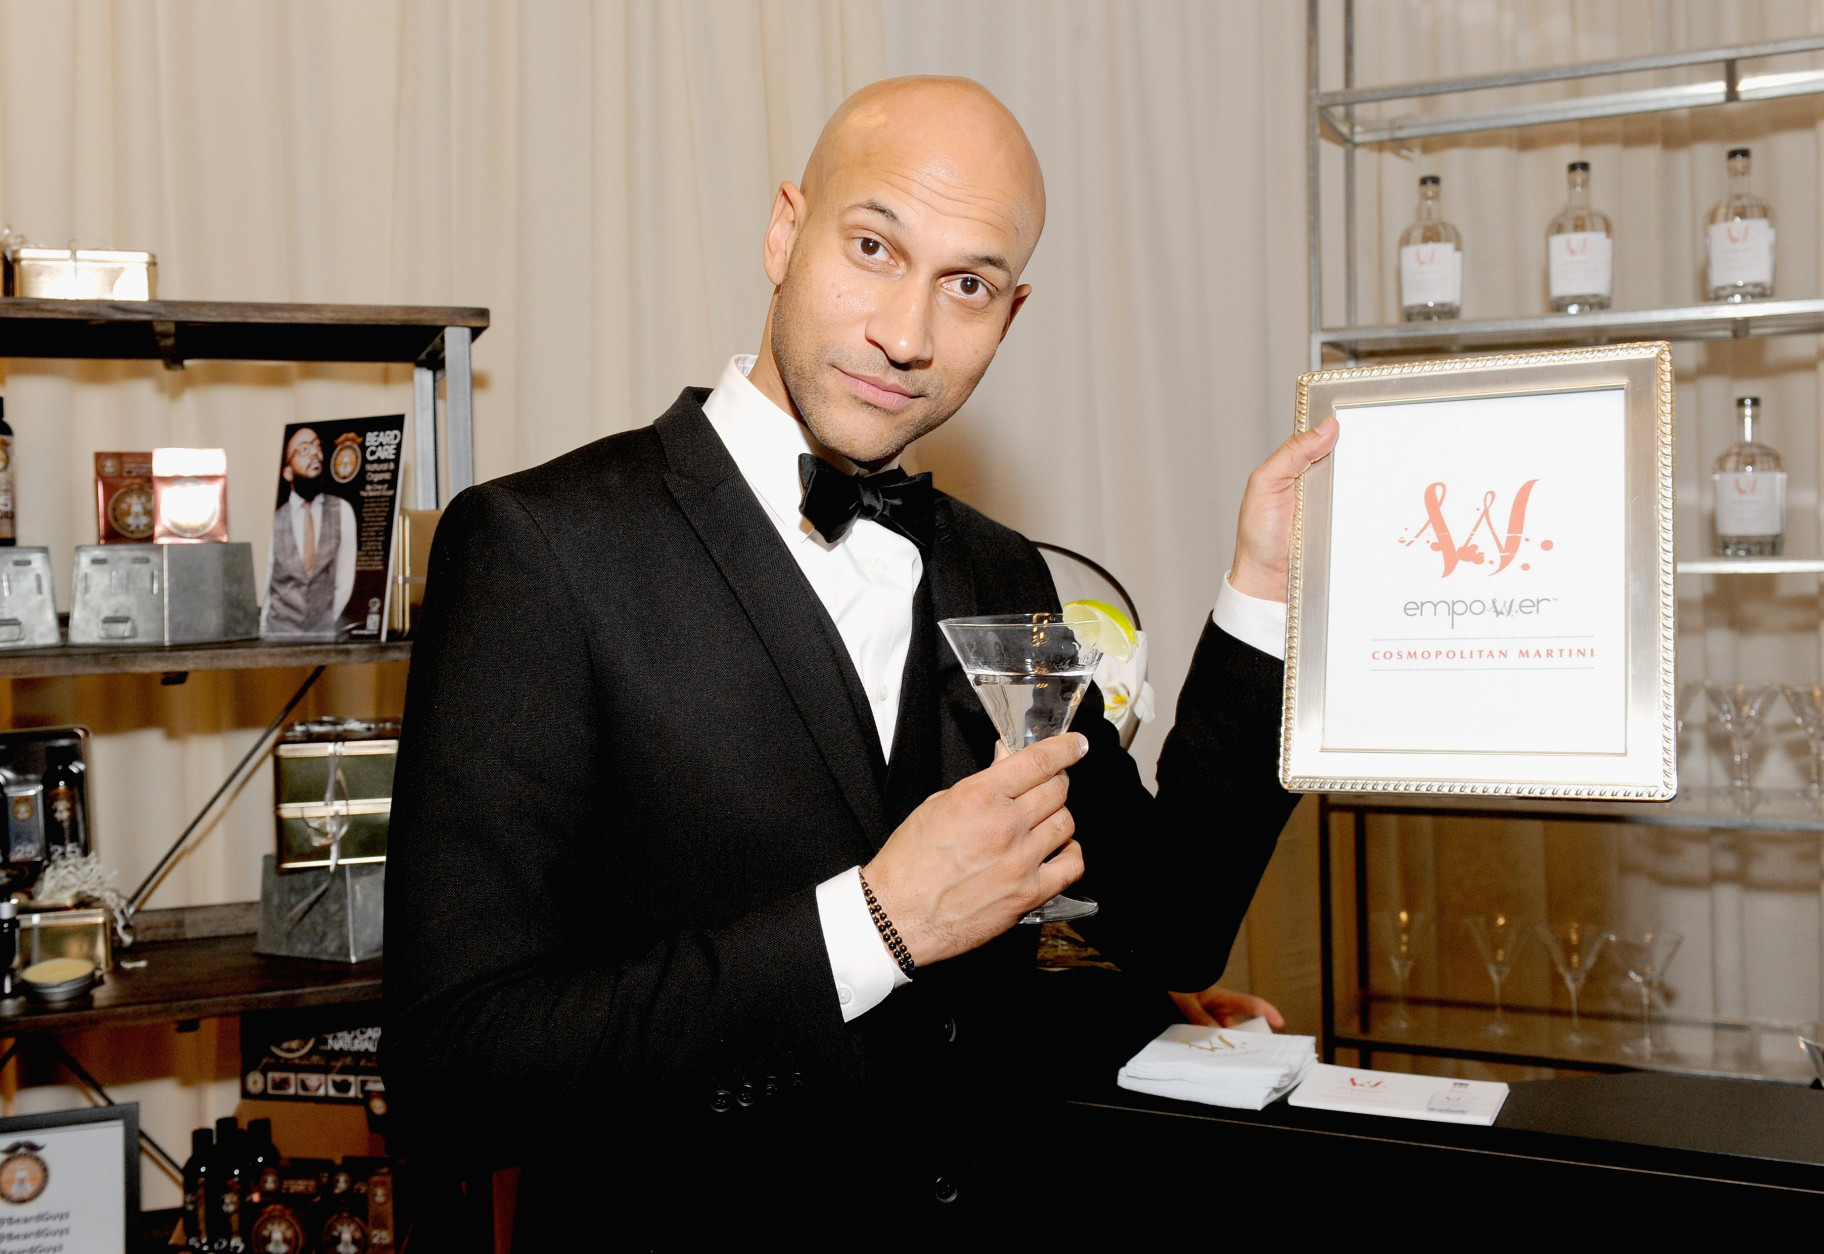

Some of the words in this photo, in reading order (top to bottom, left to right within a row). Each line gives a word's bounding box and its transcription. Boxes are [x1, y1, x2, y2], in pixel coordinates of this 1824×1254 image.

[365, 429, 402, 447] BEARD
[365, 444, 397, 461] CARE
[1371, 648, 1509, 661] COSMOPOLITAN
[1518, 647, 1595, 659] MARTINI
